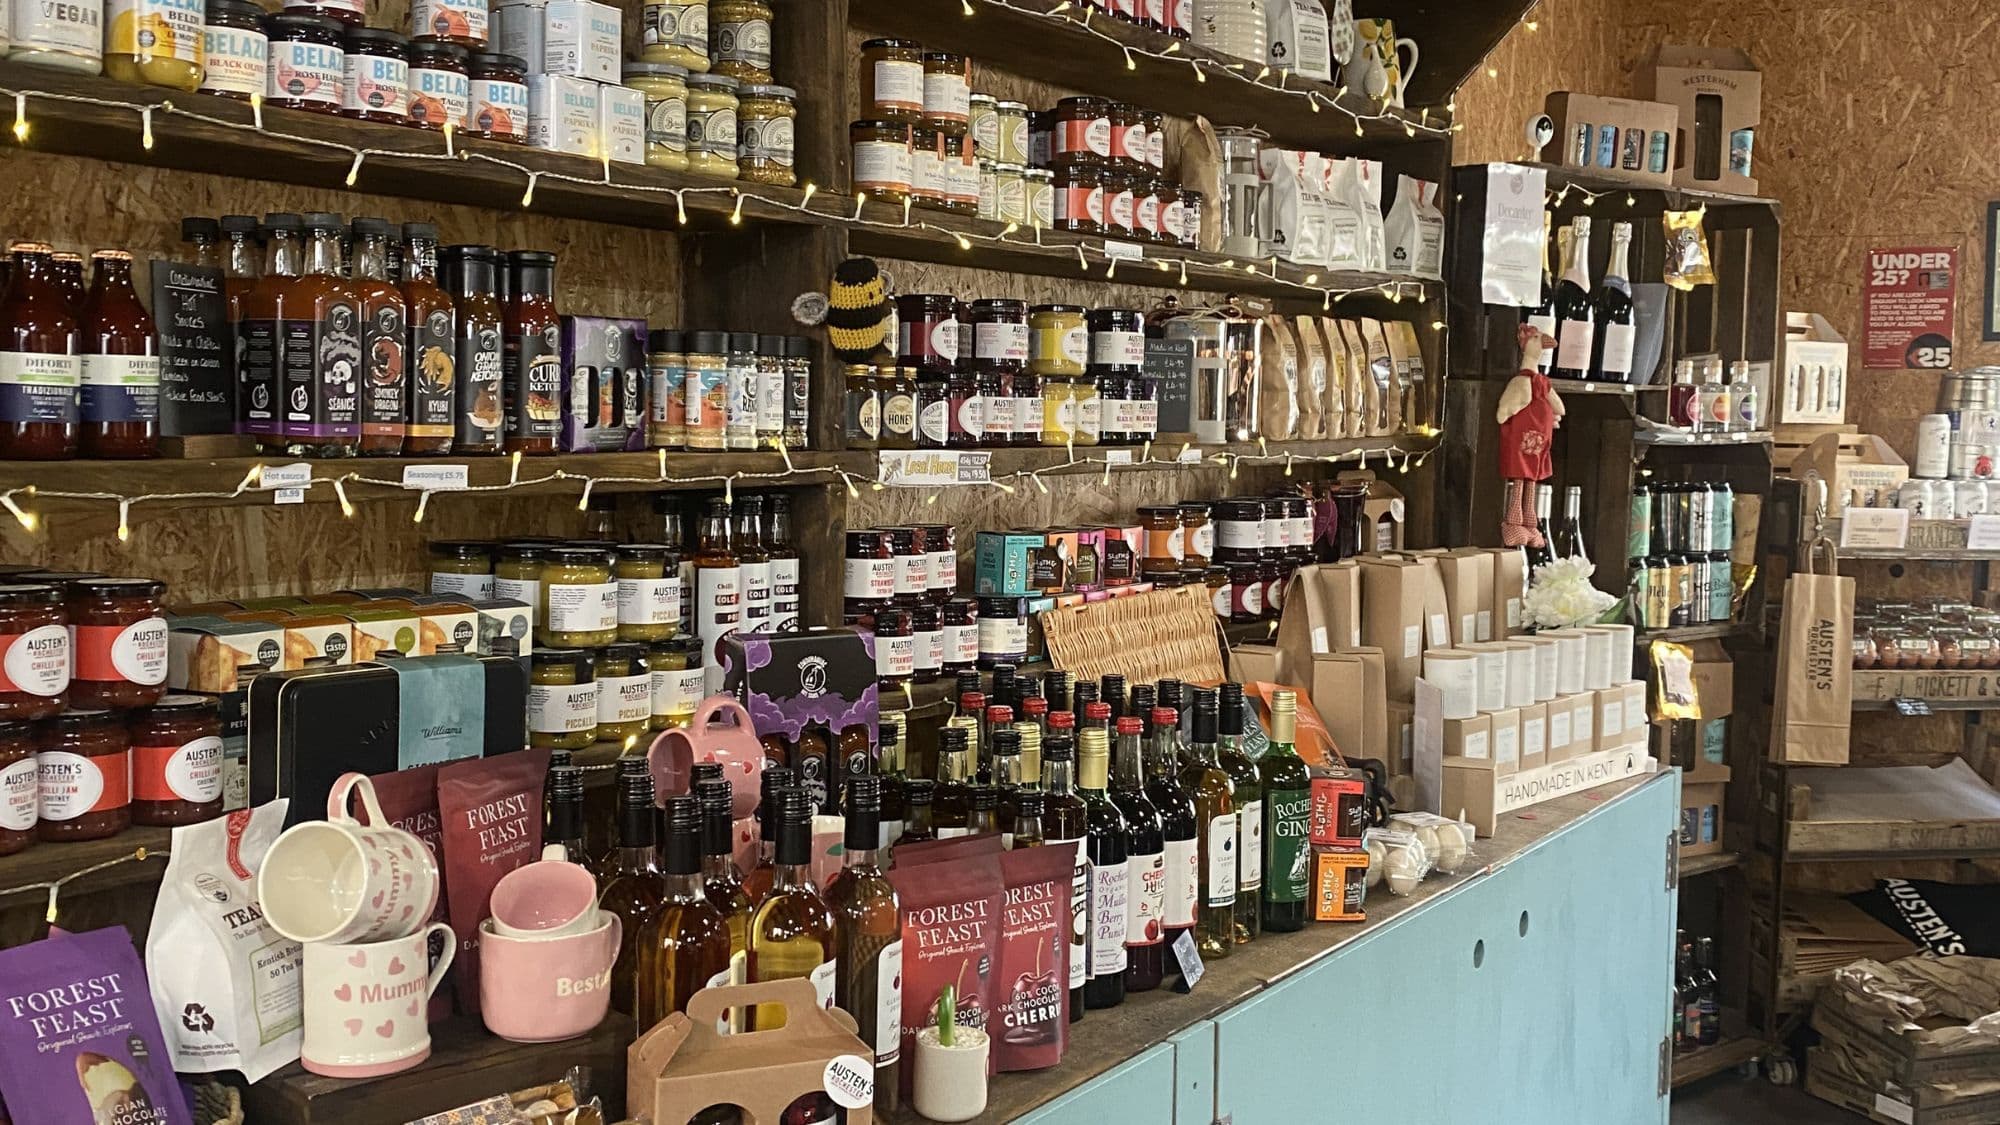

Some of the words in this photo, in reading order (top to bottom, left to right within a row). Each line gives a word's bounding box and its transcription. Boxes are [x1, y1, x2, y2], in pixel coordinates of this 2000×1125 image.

[1682, 74, 1738, 91] WESTERHAM
[1872, 253, 1951, 269] UNDER
[1871, 270, 1910, 286] 25?
[1918, 347, 1951, 367] 25
[904, 454, 930, 476] Local
[929, 454, 957, 477] Honey
[264, 472, 279, 480] Hot
[280, 472, 305, 480] sauce
[407, 470, 444, 481] Seasoning
[716, 596, 736, 604] COLD
[748, 590, 767, 598] COLD
[454, 629, 474, 639] taste
[258, 649, 279, 660] taste
[326, 641, 347, 652] taste
[1809, 626, 1817, 680] ROCHESTER
[136, 651, 156, 661] CHILLI
[1817, 619, 1834, 691] AUSTEN'S
[31, 660, 54, 671] CHILLI
[1916, 676, 1971, 697] RICKETT
[1978, 677, 1988, 696] &
[423, 725, 463, 739] Williams
[38, 763, 82, 777] USTEN'S
[189, 771, 210, 780] CHILLI
[38, 775, 76, 783] OCHESTER
[1504, 771, 1572, 803] HANDMADE
[1573, 769, 1585, 786] IN
[1587, 761, 1615, 781] KENT
[61, 786, 79, 795] JAM
[9, 797, 29, 806] CHILLI
[466, 794, 528, 830] FOREST
[479, 816, 529, 850] FEAST
[907, 900, 988, 928] FOREST
[1884, 878, 1966, 956] AUSTEN'S
[917, 920, 987, 948] FEAST
[257, 952, 285, 970] Kentish
[270, 969, 280, 980] 50
[281, 963, 294, 975] Tea
[6, 973, 123, 1018] FOREST
[1015, 990, 1033, 1001] 60%
[30, 998, 123, 1039] FEAST
[829, 1062, 874, 1096] AUSTEN'S
[831, 1075, 864, 1099] ROCHESTER
